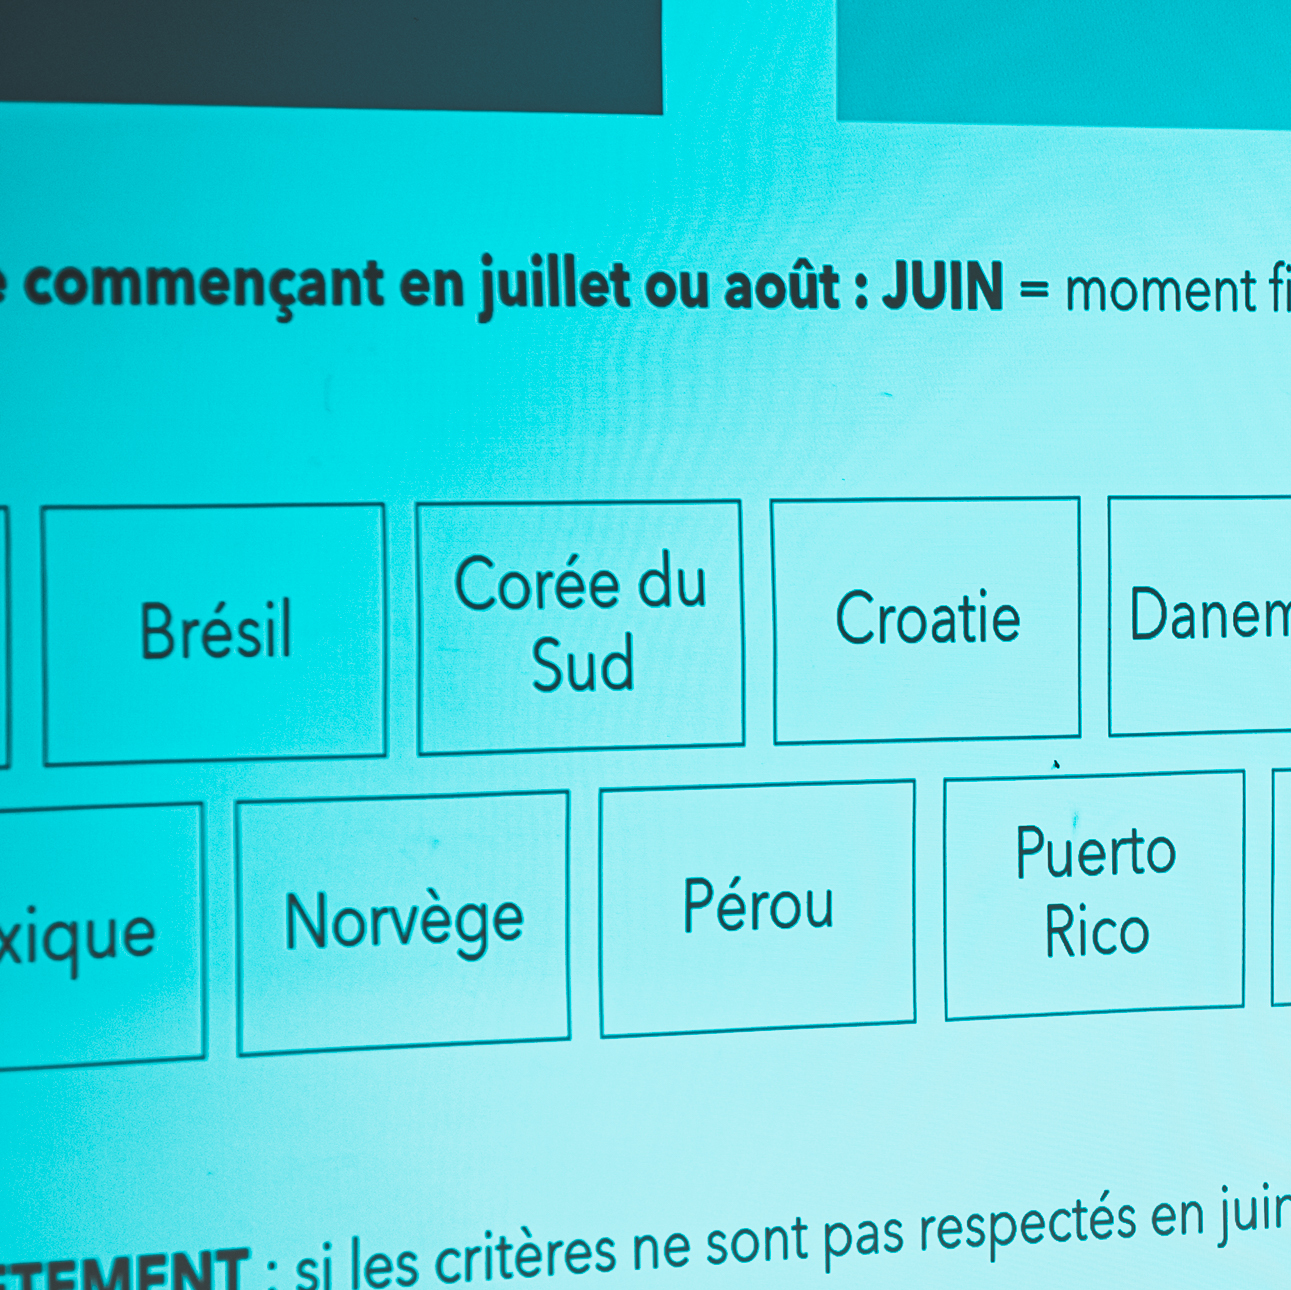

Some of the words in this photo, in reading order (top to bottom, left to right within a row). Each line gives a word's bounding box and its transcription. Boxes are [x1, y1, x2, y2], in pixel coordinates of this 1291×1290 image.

[22, 259, 386, 325] commençant
[399, 268, 465, 308] en
[477, 251, 631, 325] juillet
[645, 271, 709, 309] ou
[724, 257, 840, 309] août
[855, 272, 868, 310] :
[882, 259, 1003, 311] JUIN
[1020, 281, 1049, 298] =
[1067, 270, 1257, 312] moment
[455, 553, 619, 611] Corée
[639, 548, 705, 607] du
[141, 596, 291, 660] Brésil
[836, 588, 1020, 645] Croatie
[533, 631, 633, 693] Sud
[1017, 825, 1176, 879] Puerto
[287, 887, 523, 962] Norvège
[685, 875, 832, 933] Pérou
[1046, 902, 1149, 958] Rico
[352, 1236, 418, 1290] les
[436, 1226, 616, 1284] critères
[634, 1233, 690, 1270] ne
[707, 1216, 808, 1265] sont
[824, 1219, 904, 1274] pas
[921, 1189, 1136, 1263] respectés
[1151, 1201, 1203, 1236] en
